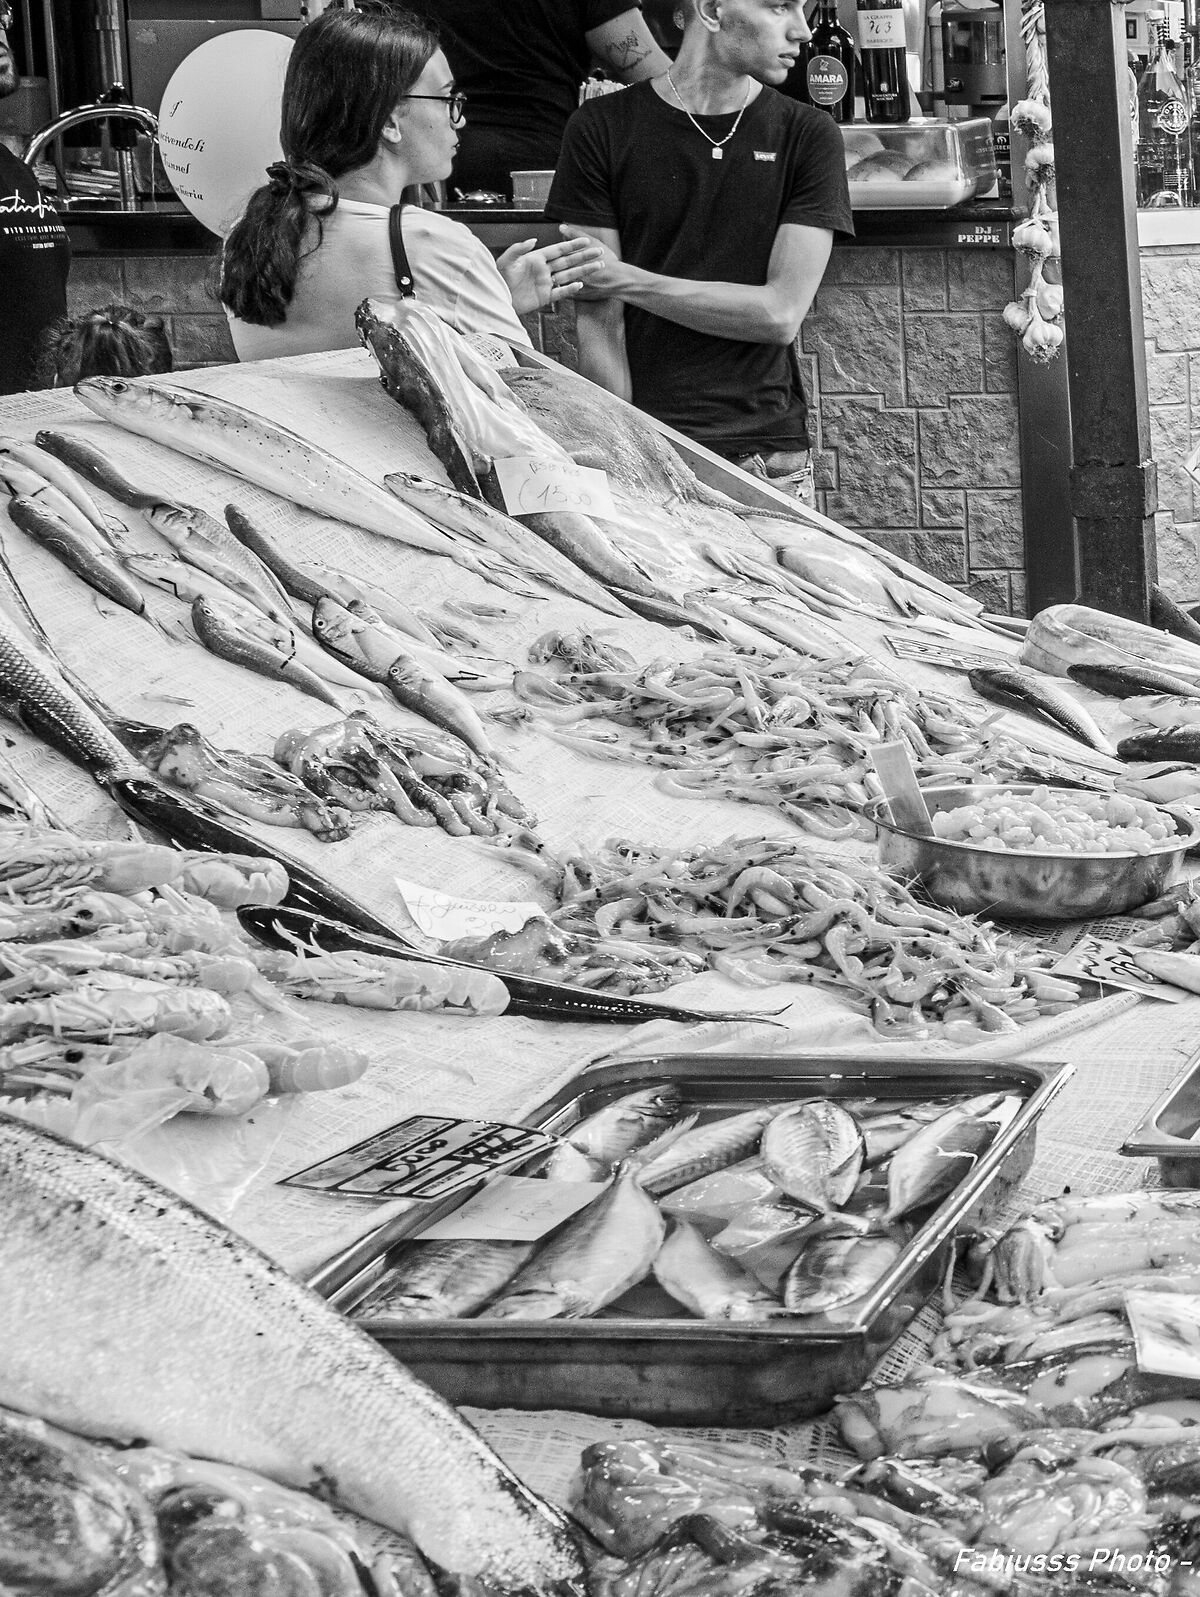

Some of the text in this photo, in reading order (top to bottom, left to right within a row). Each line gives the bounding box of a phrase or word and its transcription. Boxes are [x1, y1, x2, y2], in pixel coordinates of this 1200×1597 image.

[809, 74, 844, 83] AMARA
[975, 226, 992, 234] DJ
[958, 234, 1000, 243] PEPPE
